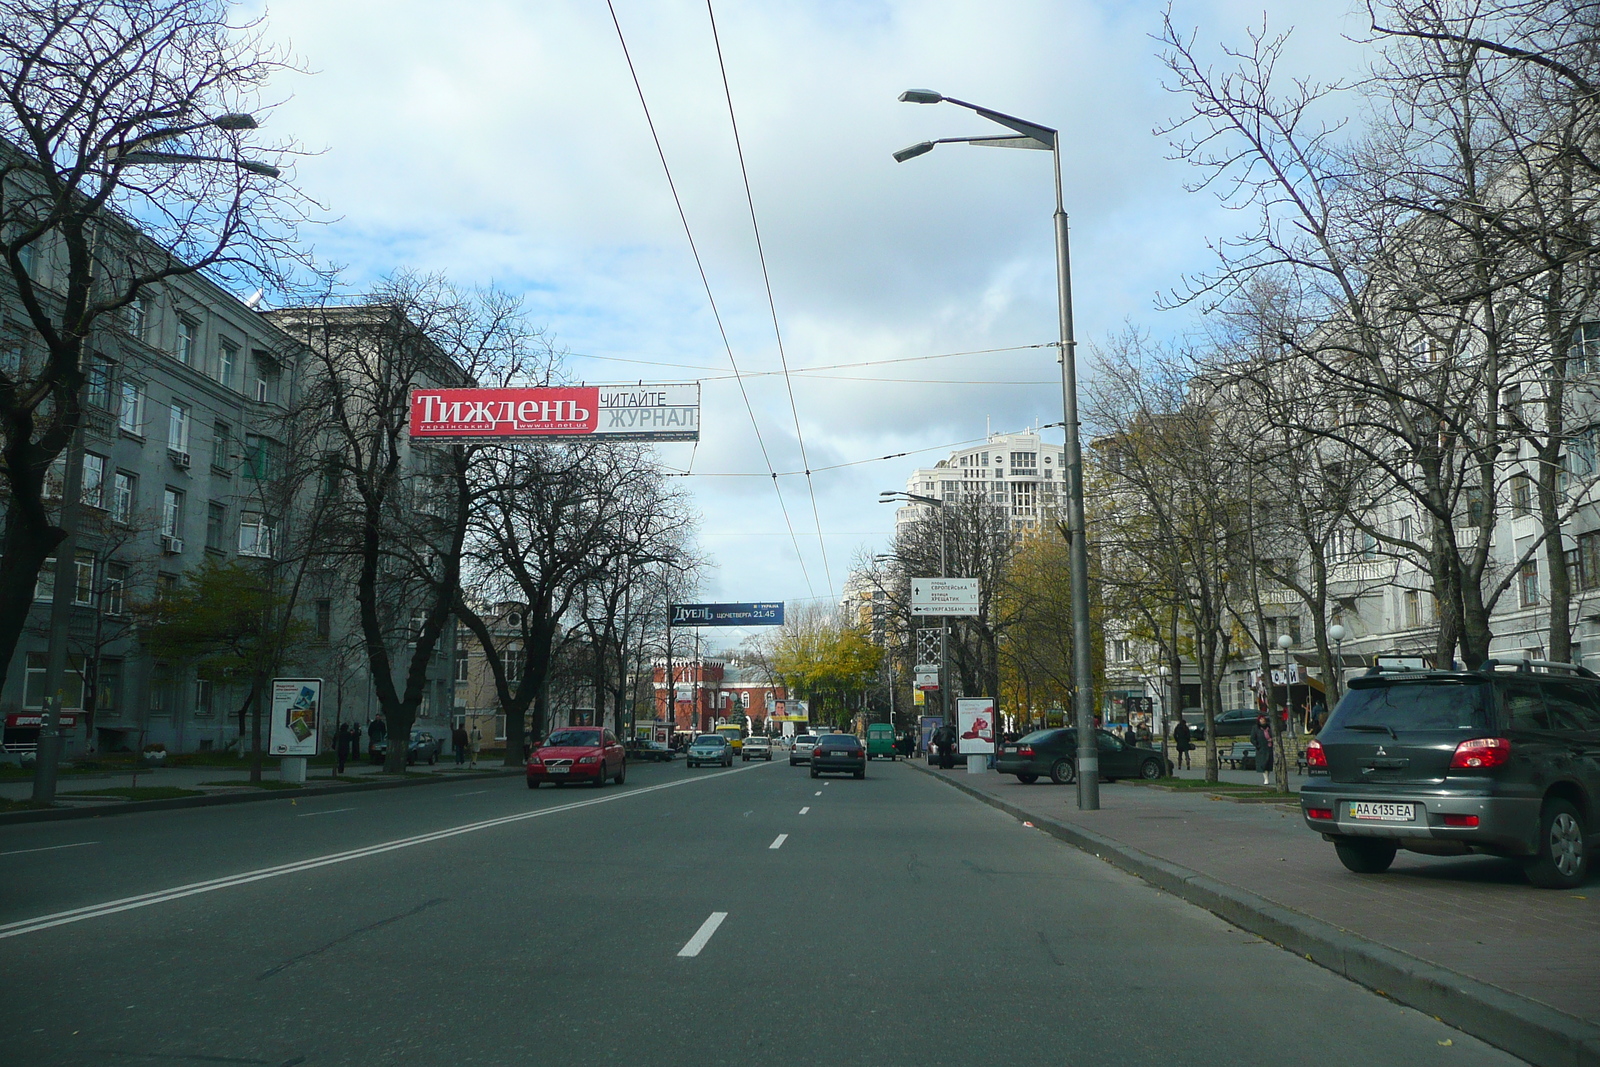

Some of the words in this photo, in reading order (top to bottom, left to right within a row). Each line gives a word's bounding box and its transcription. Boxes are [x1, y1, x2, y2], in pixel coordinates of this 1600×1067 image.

[600, 390, 666, 407] ЧИТАЙТЕ
[417, 395, 590, 430] Тиждень
[608, 408, 695, 427] ЖУРНАЛ
[753, 610, 776, 618] 21.45
[1372, 804, 1395, 815] 6135
